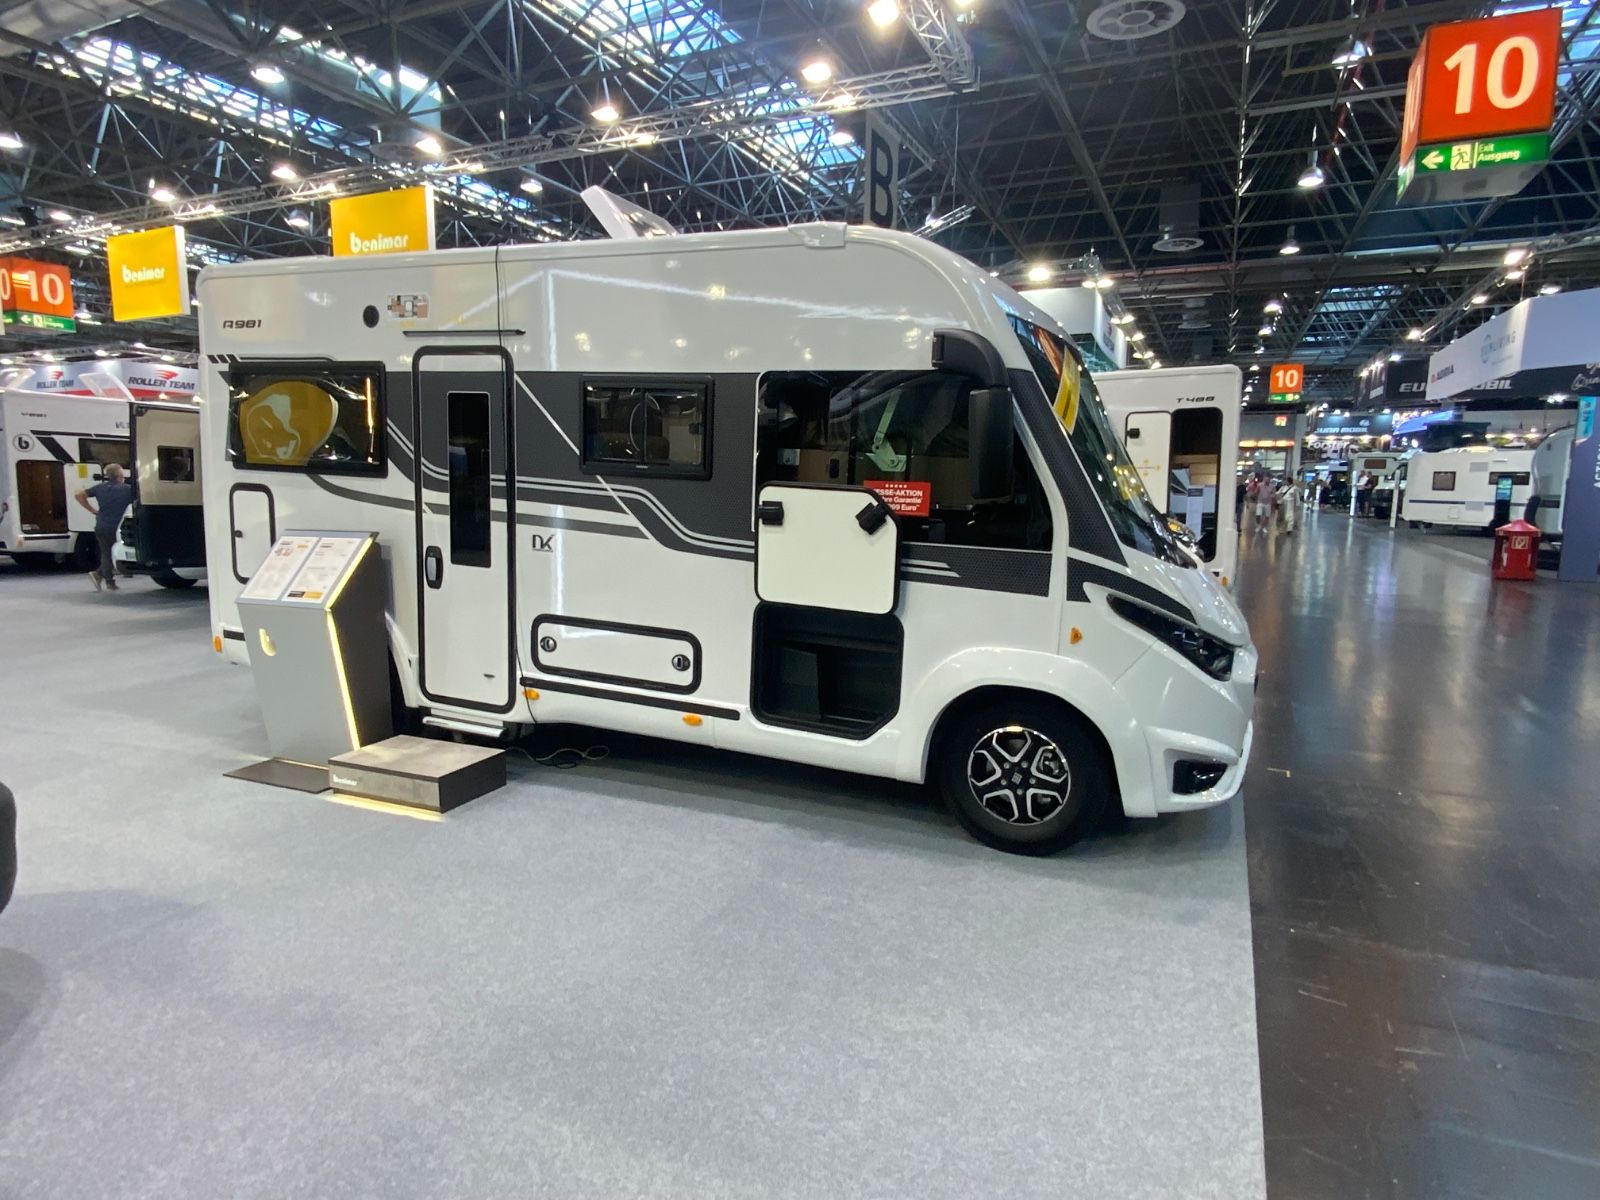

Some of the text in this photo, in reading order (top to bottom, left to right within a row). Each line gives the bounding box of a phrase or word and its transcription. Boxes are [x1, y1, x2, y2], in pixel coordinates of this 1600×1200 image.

[1443, 36, 1539, 115] 10
[1477, 150, 1521, 162] Ausgang
[1478, 143, 1495, 152] Exit
[870, 128, 893, 228] B
[350, 231, 409, 254] benimar
[121, 264, 166, 284] benimar
[25, 270, 65, 305] 10
[36, 380, 58, 389] ROLLER
[127, 376, 196, 390] ROLLER TEAM
[1275, 369, 1299, 388] 10
[1307, 439, 1350, 450] Forster
